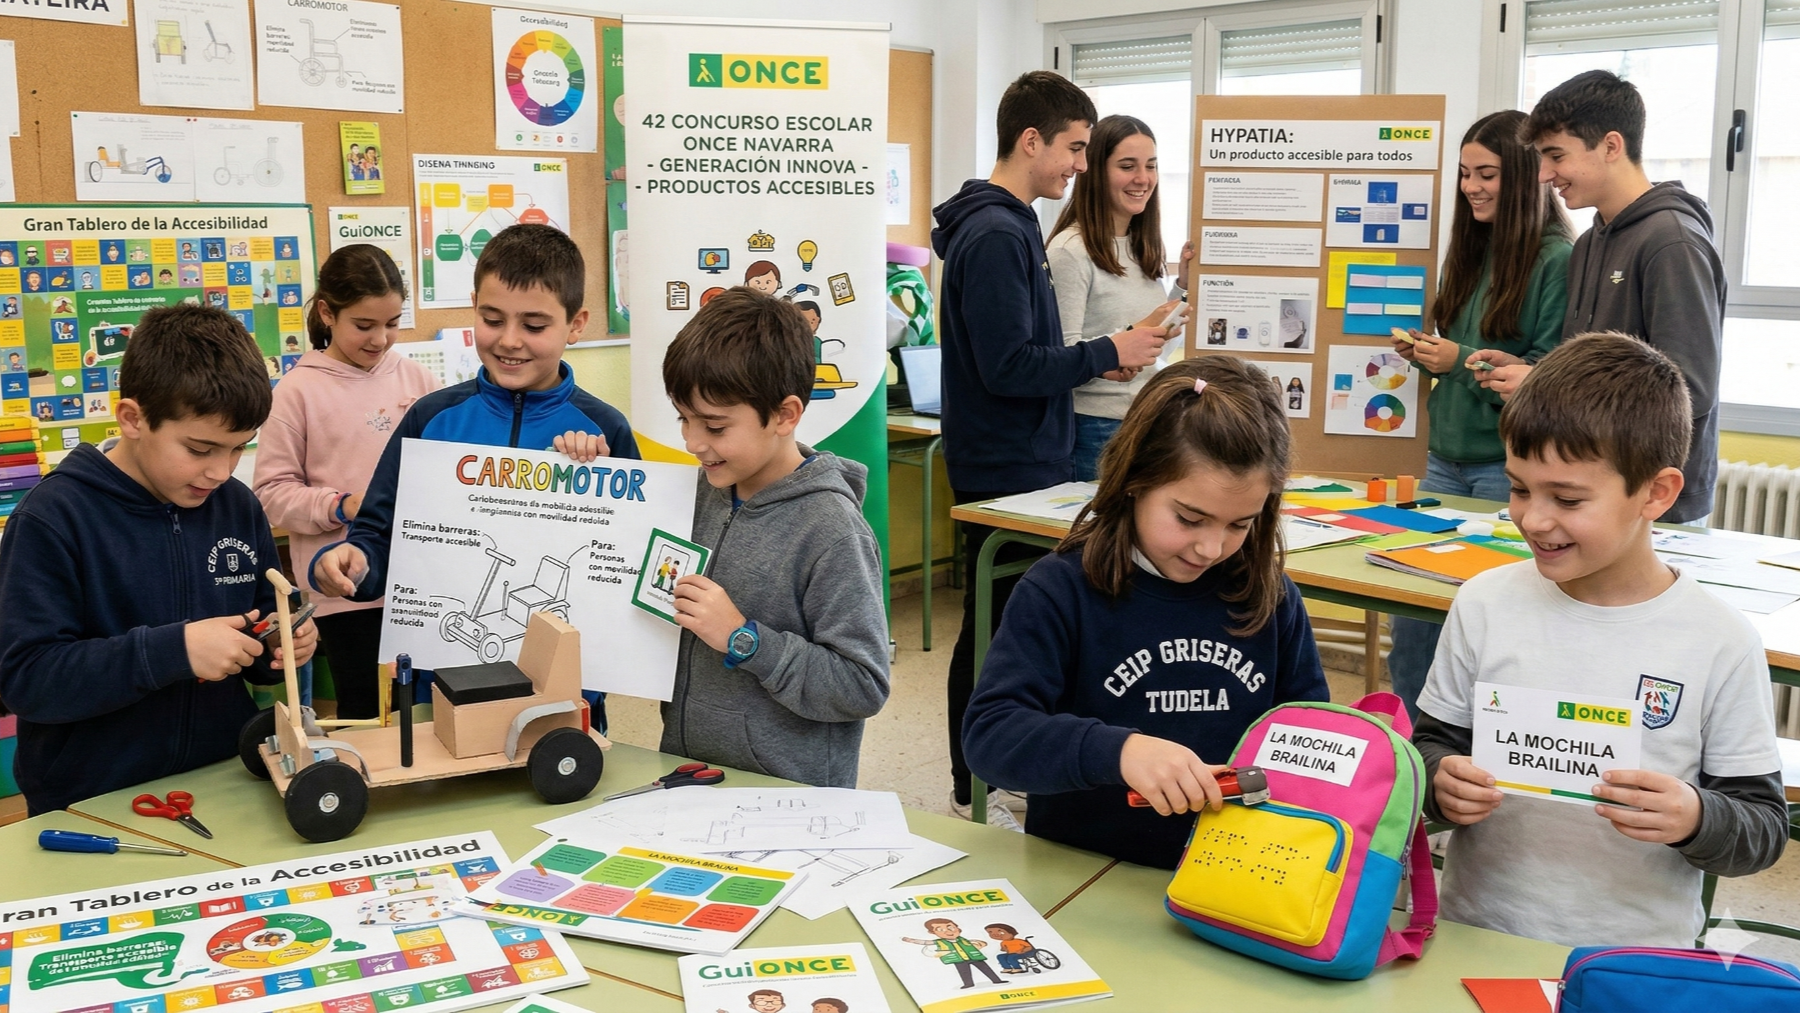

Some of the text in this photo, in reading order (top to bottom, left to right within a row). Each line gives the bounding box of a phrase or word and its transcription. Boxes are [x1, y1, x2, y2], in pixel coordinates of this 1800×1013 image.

[729, 60, 822, 85] ONCE
[642, 114, 873, 132] 42 CONCURSO ESCOLAR
[1210, 128, 1294, 143] HYPATIA:
[1393, 129, 1430, 139] ONCE
[683, 137, 834, 152] ONCE NAVARRA
[659, 156, 781, 173] GENERACIÓN
[788, 160, 856, 174] INNOVA
[1209, 149, 1413, 163] Un producto accesible para todos
[648, 179, 761, 194] PRODUCTOS
[766, 180, 875, 195] ACCESIBLES
[24, 216, 268, 232] Gran Tablero de la Accesibilidad
[339, 225, 402, 238] GuiONCE
[456, 454, 646, 502] CARROMOTOR
[523, 511, 537, 519] con
[402, 519, 481, 537] Elimina barreras:
[401, 532, 481, 547] Transporte accesible
[591, 540, 616, 551] Para:
[207, 545, 219, 573] CEIP
[589, 552, 625, 563] Personas
[587, 575, 622, 584] reducida
[394, 584, 418, 595] Para:
[392, 595, 443, 608] Personas con
[390, 617, 424, 627] reducida
[1103, 638, 1266, 697] CEIP GRISERAS
[1145, 688, 1230, 713] TUDELA
[1578, 706, 1627, 725] ONCE
[1269, 731, 1356, 759] LA MOCHILA
[1495, 729, 1615, 760] LA MOCHILA
[1269, 749, 1336, 774] BRAILINA
[1508, 751, 1600, 778] BRAILINA
[2, 839, 481, 923] ran Tablero de la Accesibilidad
[869, 891, 1004, 915] GuiONCE
[698, 957, 851, 980] GuiONCE
